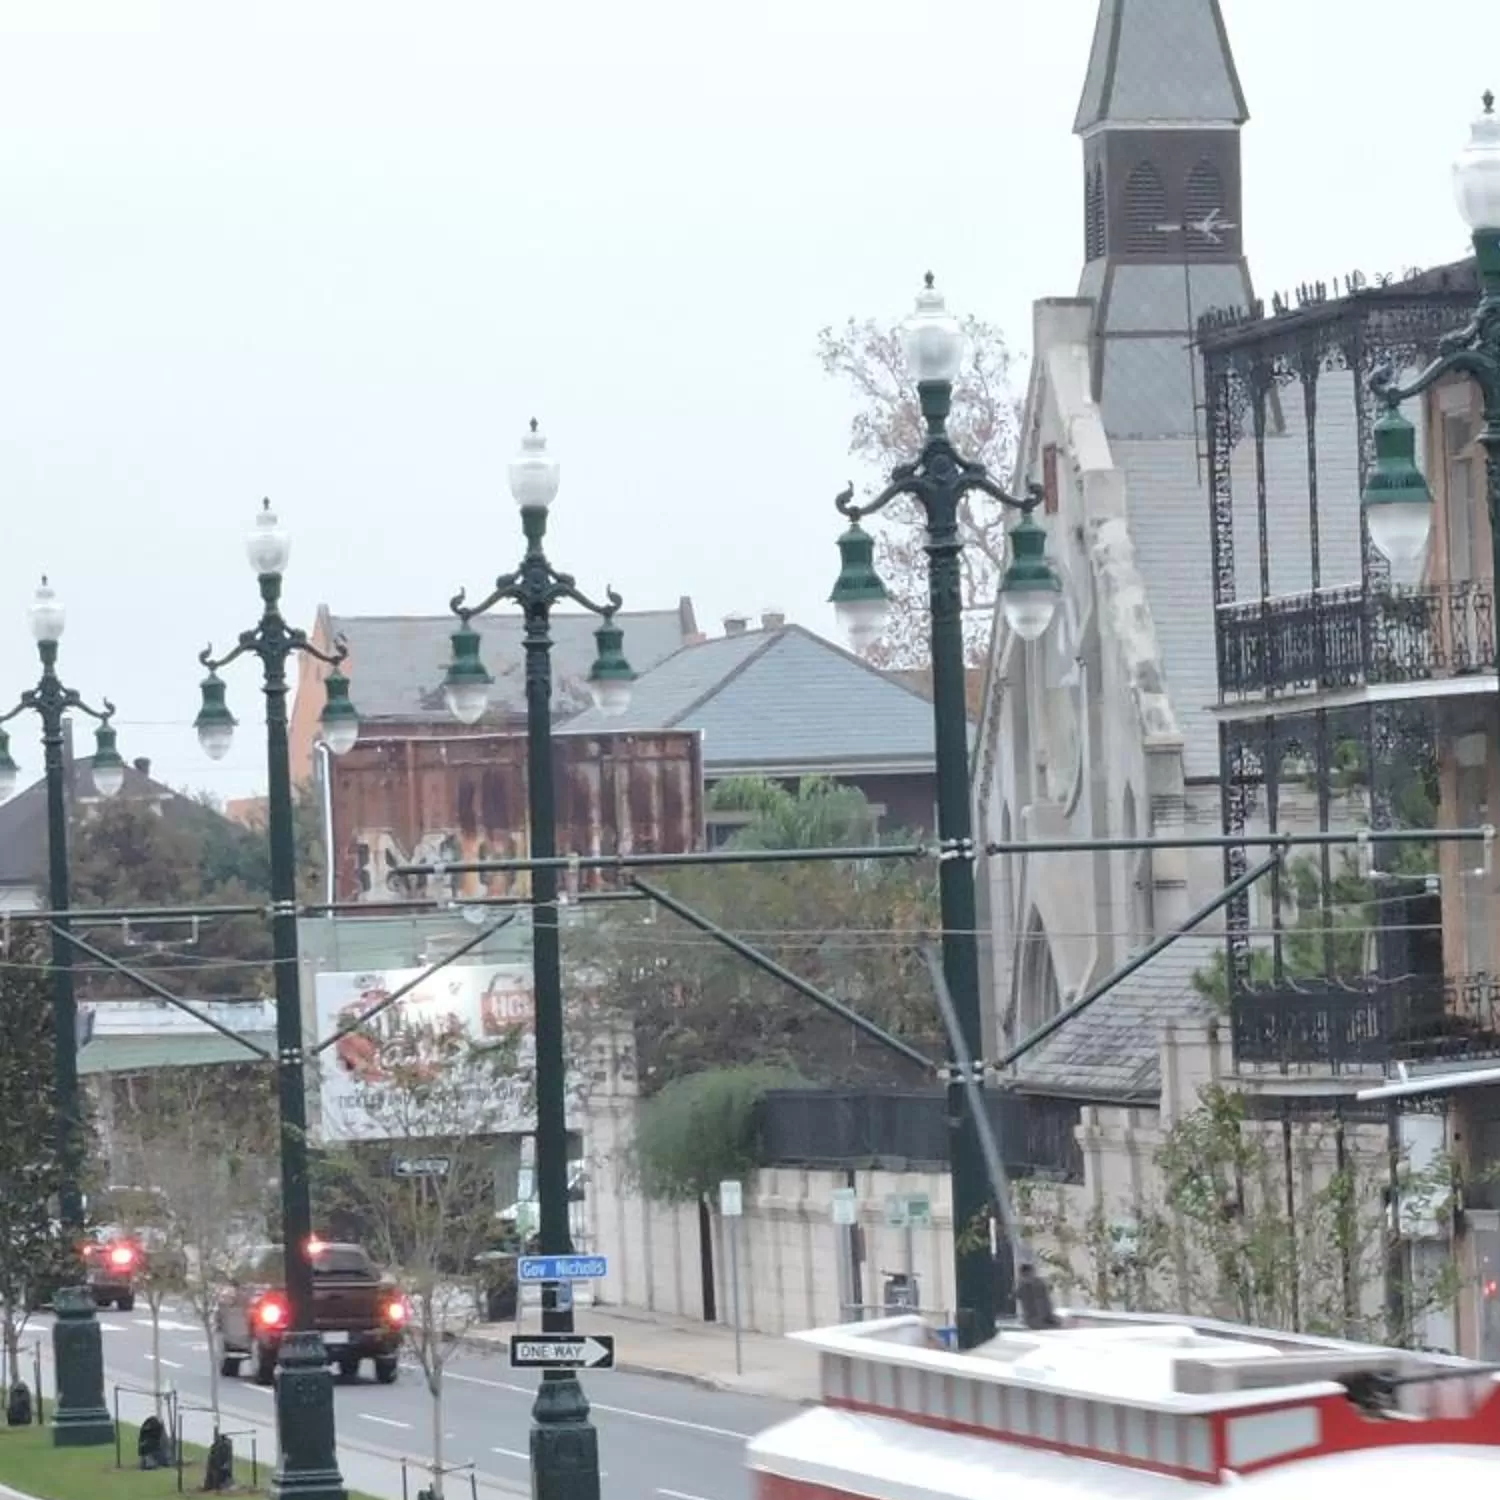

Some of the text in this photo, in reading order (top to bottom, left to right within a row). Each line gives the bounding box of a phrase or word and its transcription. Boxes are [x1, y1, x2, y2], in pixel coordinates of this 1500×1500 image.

[523, 1260, 547, 1277] Gov
[520, 1342, 582, 1357] ONE WAY
